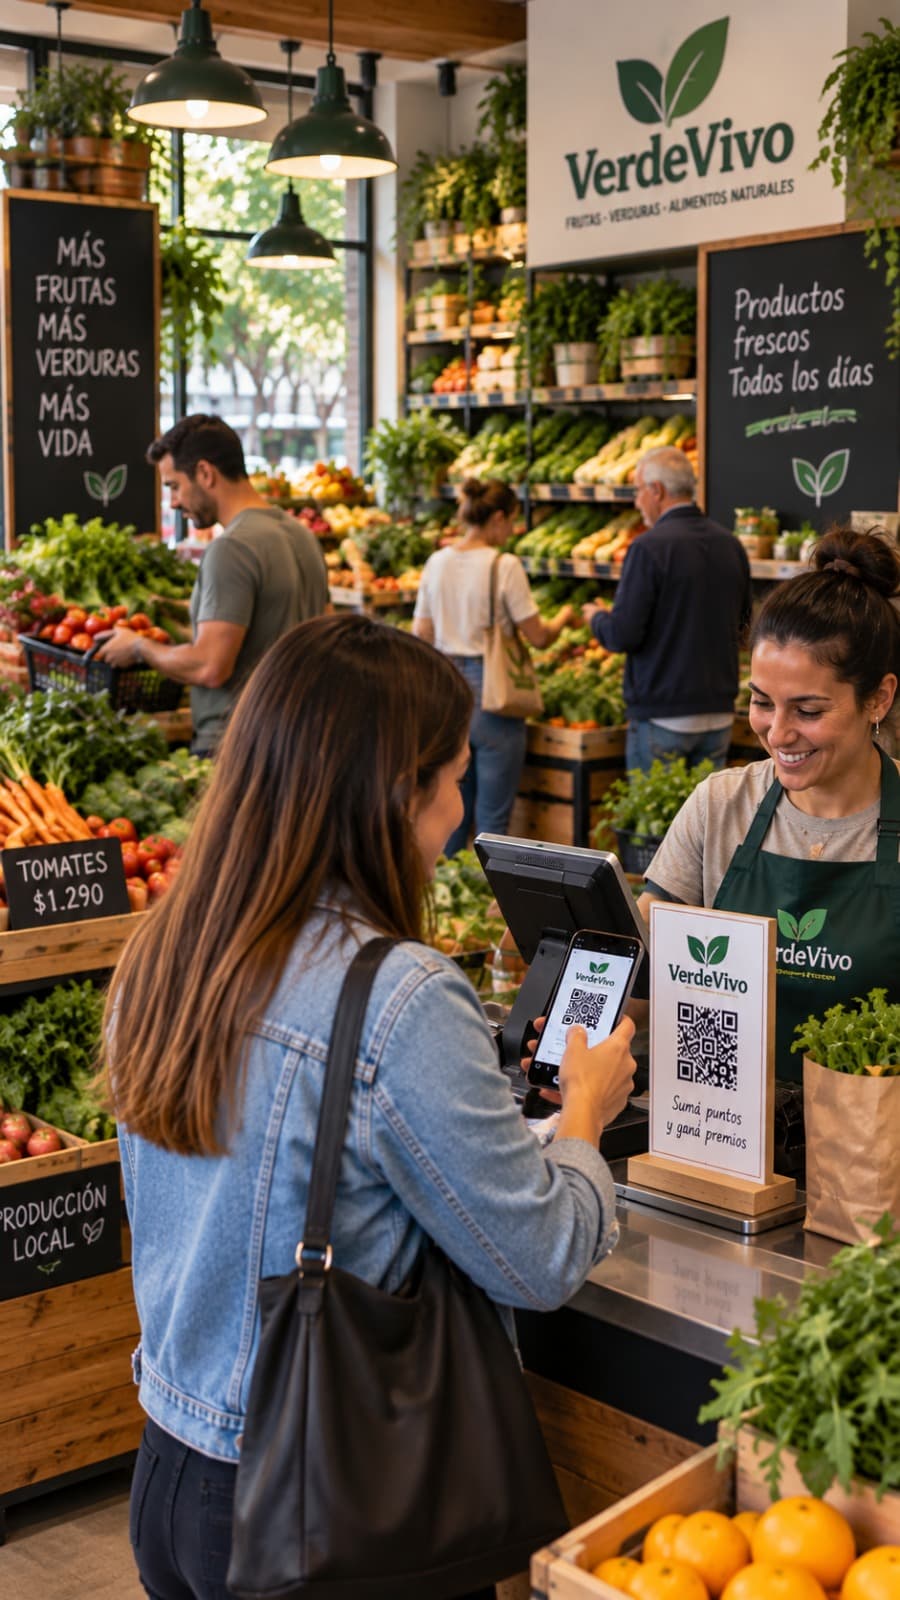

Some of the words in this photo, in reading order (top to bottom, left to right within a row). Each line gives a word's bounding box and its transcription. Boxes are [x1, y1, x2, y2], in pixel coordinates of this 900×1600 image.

[564, 117, 794, 200] VerdeVivo
[565, 212, 602, 230] FRUTAS
[609, 202, 661, 223] VERDURAS
[668, 190, 727, 213] ALIMENTOS
[730, 178, 795, 202] NATURALES
[57, 230, 106, 268] MÁS
[35, 275, 117, 305] FRUTAS
[734, 281, 845, 322] Productos
[37, 306, 87, 342] MÁS
[733, 325, 810, 360] frescos
[35, 348, 140, 377] VERDURAS
[728, 363, 784, 398] Todos
[791, 359, 819, 392] los
[827, 355, 874, 389] días
[39, 383, 90, 421] MÁS
[38, 428, 93, 457] VIDA
[16, 851, 108, 882] TOMATES
[33, 883, 104, 916] $1.290
[776, 942, 853, 971] rdeVivo
[575, 972, 615, 987] VerdeVivo
[668, 963, 749, 994] VerdeVivo
[672, 1095, 701, 1116] Sumá
[705, 1108, 742, 1126] puntos
[666, 1121, 673, 1135] y
[676, 1121, 701, 1138] ganá
[705, 1130, 747, 1149] premios
[13, 1226, 75, 1262] LOCAL
